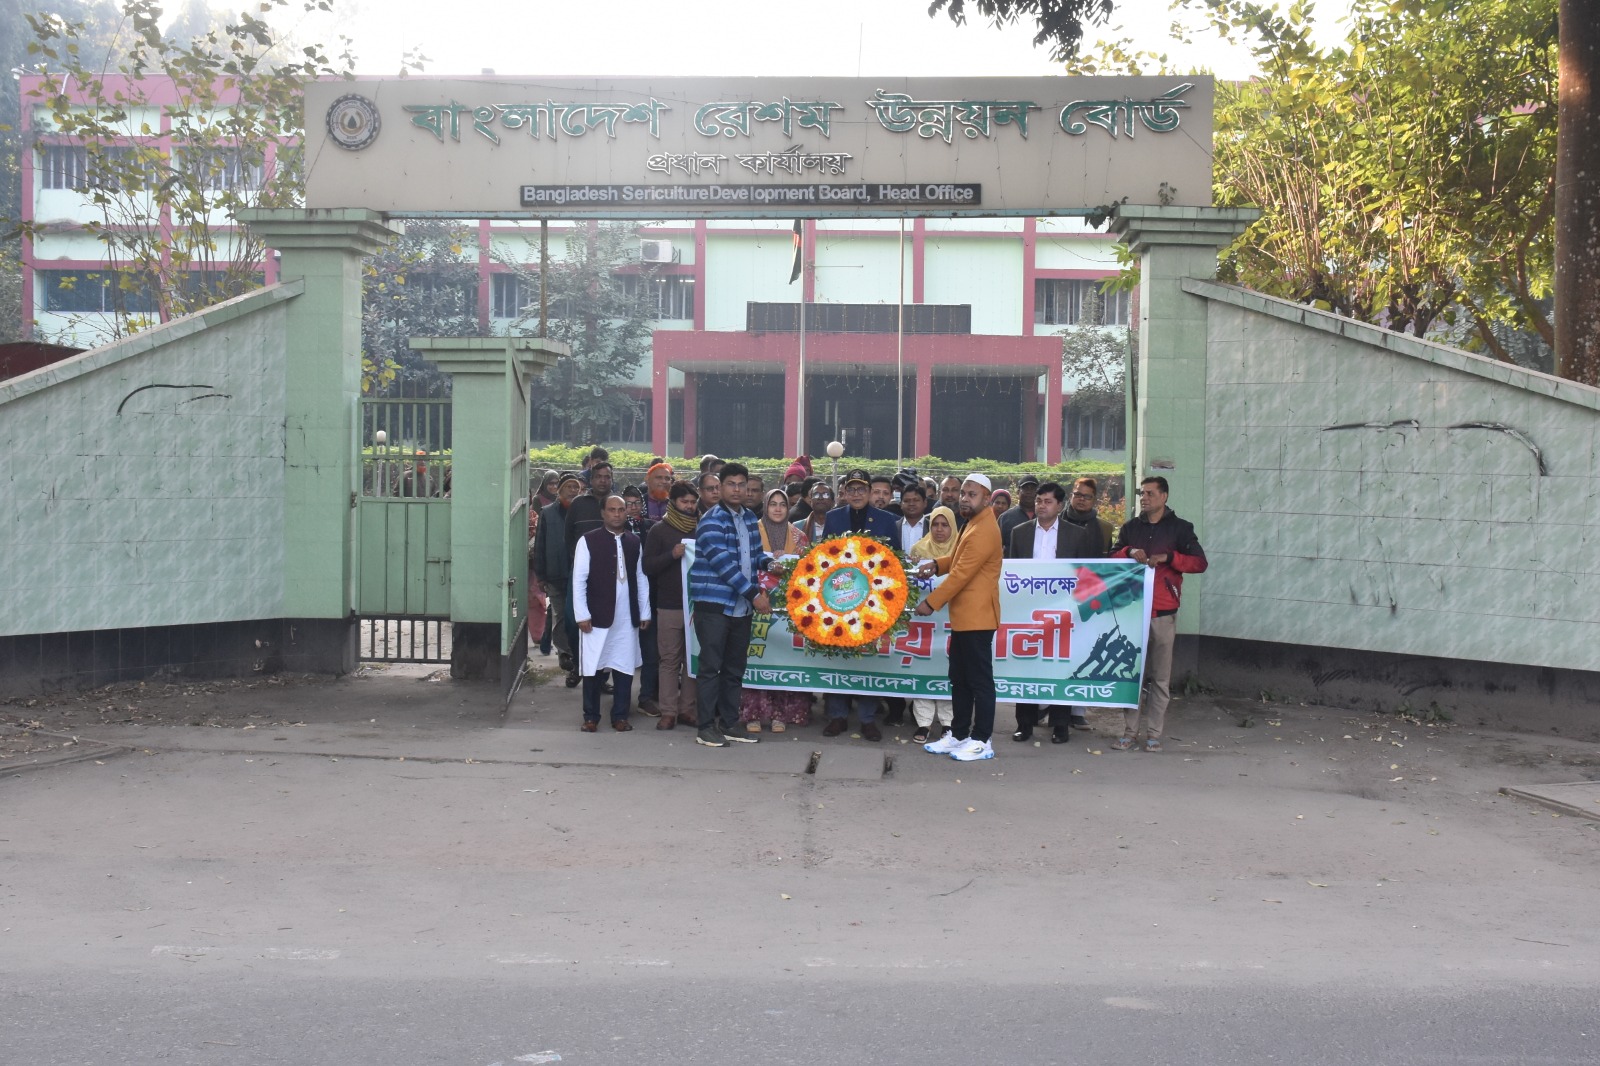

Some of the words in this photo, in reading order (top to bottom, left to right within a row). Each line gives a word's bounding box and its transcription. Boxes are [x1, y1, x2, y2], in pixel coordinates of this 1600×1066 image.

[403, 98, 671, 145] বাংলাদেশ
[694, 96, 844, 139] রেশম
[865, 88, 1042, 144] উন্নয়ন
[1059, 83, 1196, 139] বোর্ড
[646, 151, 729, 175] প্রধান
[735, 144, 853, 175] কার্যালয়
[523, 186, 618, 204] Bangladesh
[818, 185, 871, 202] Board,
[879, 184, 920, 200] Head
[925, 184, 974, 200] Office
[1003, 570, 1078, 595] উপলক্ষে
[818, 671, 920, 691] বাংলাদেশ
[1064, 681, 1118, 699] বোর্ড
